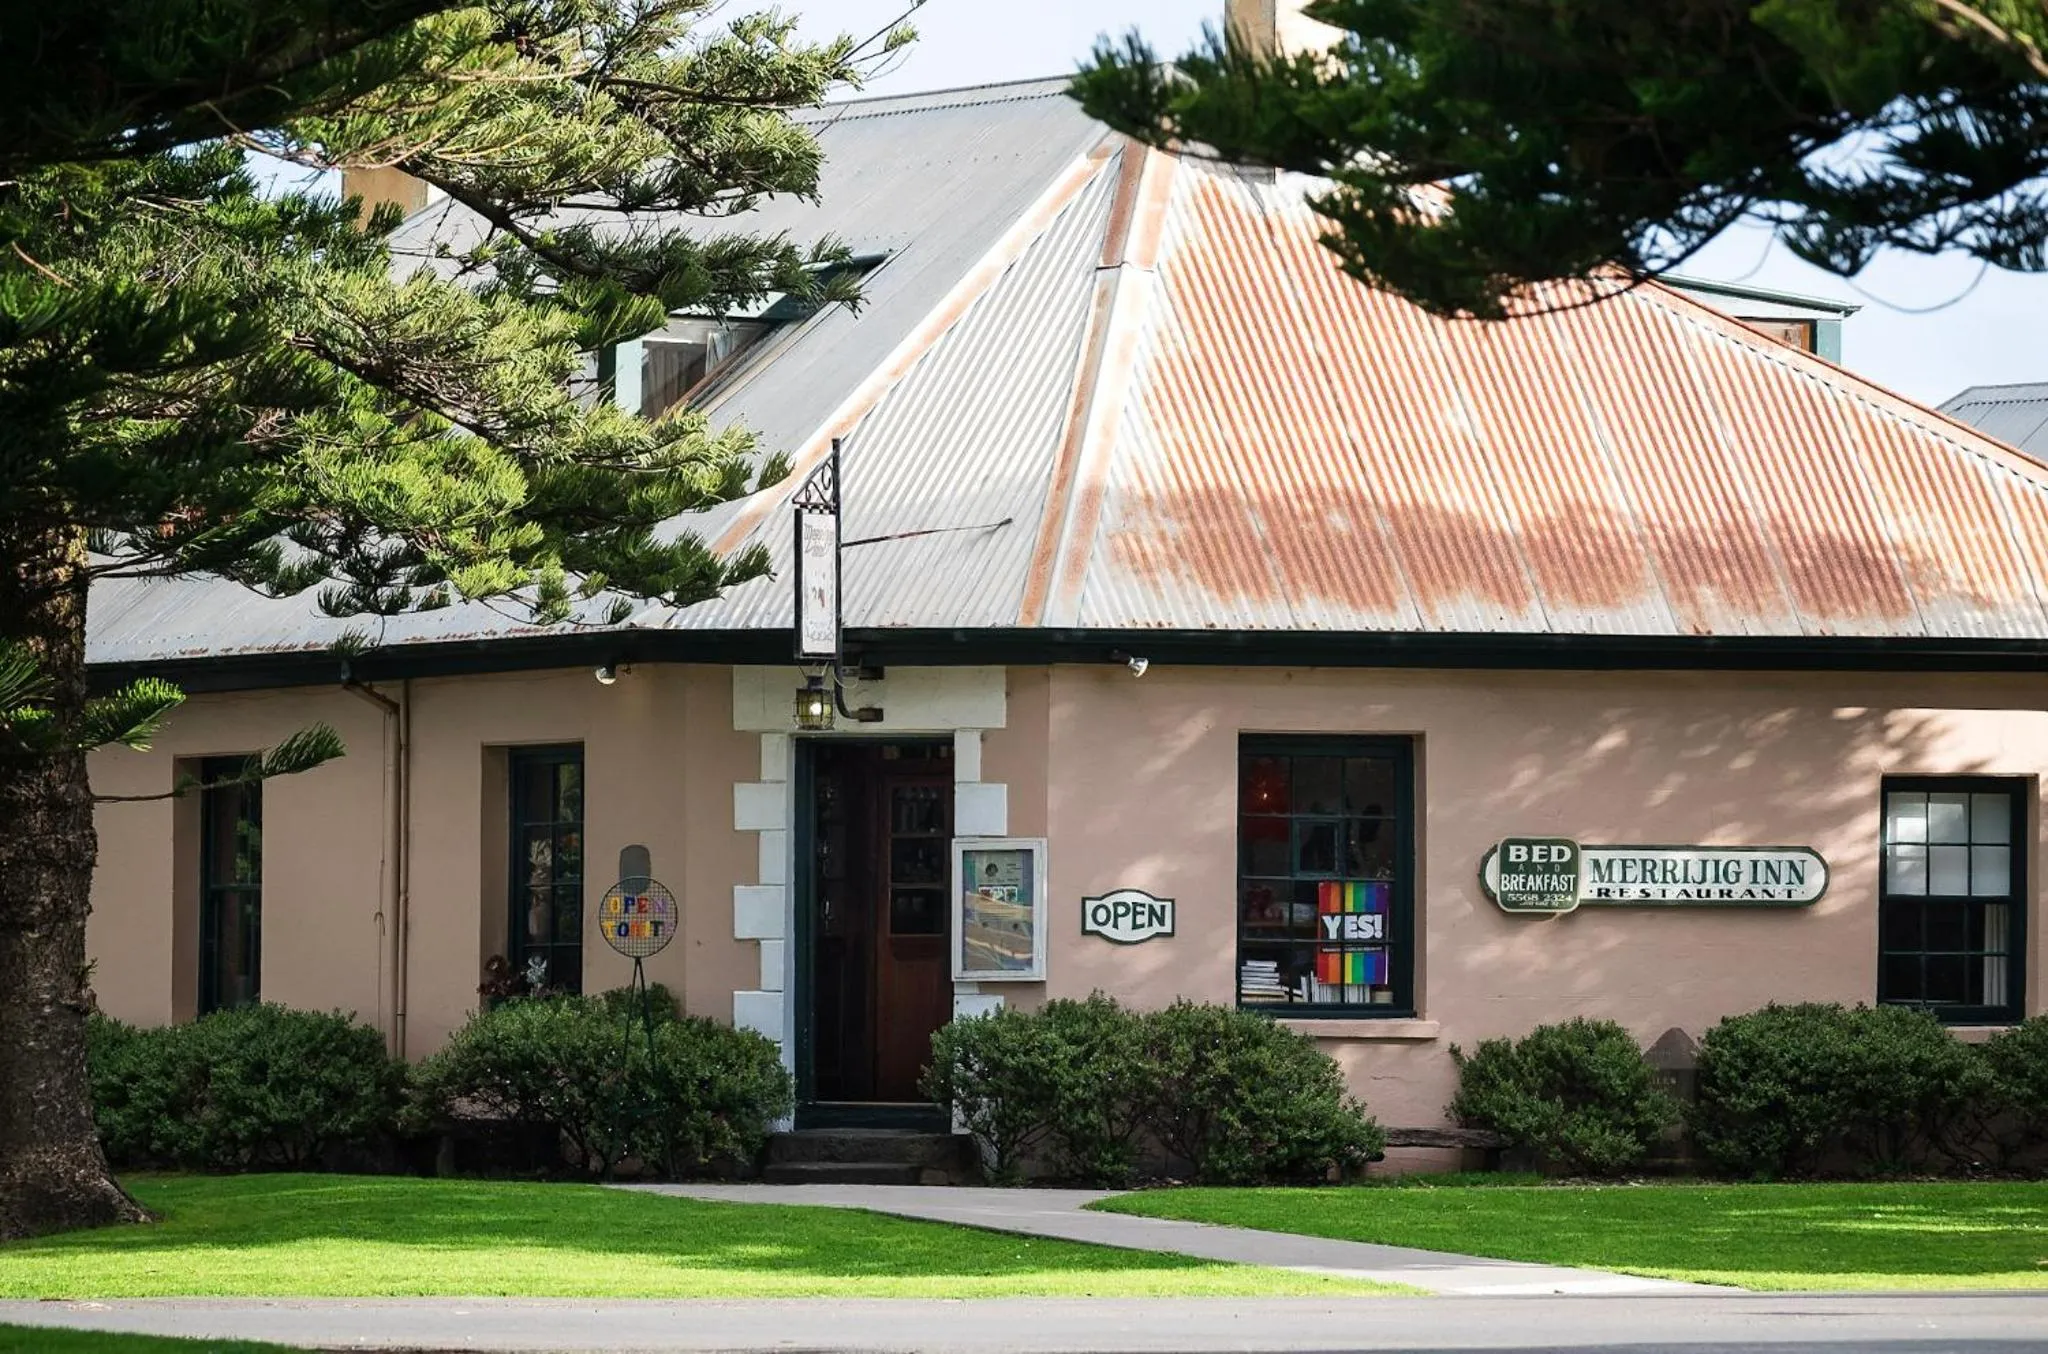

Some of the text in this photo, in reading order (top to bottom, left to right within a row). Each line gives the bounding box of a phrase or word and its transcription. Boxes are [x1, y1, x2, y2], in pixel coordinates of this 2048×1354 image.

[1508, 845, 1572, 862] BED
[1518, 863, 1561, 873] AND
[1588, 858, 1808, 886] MERRIJIG INN
[1501, 873, 1576, 892] BREAKFAST
[608, 896, 668, 914] OPEN
[1091, 901, 1167, 930] OPEN
[1321, 914, 1383, 940] YES!
